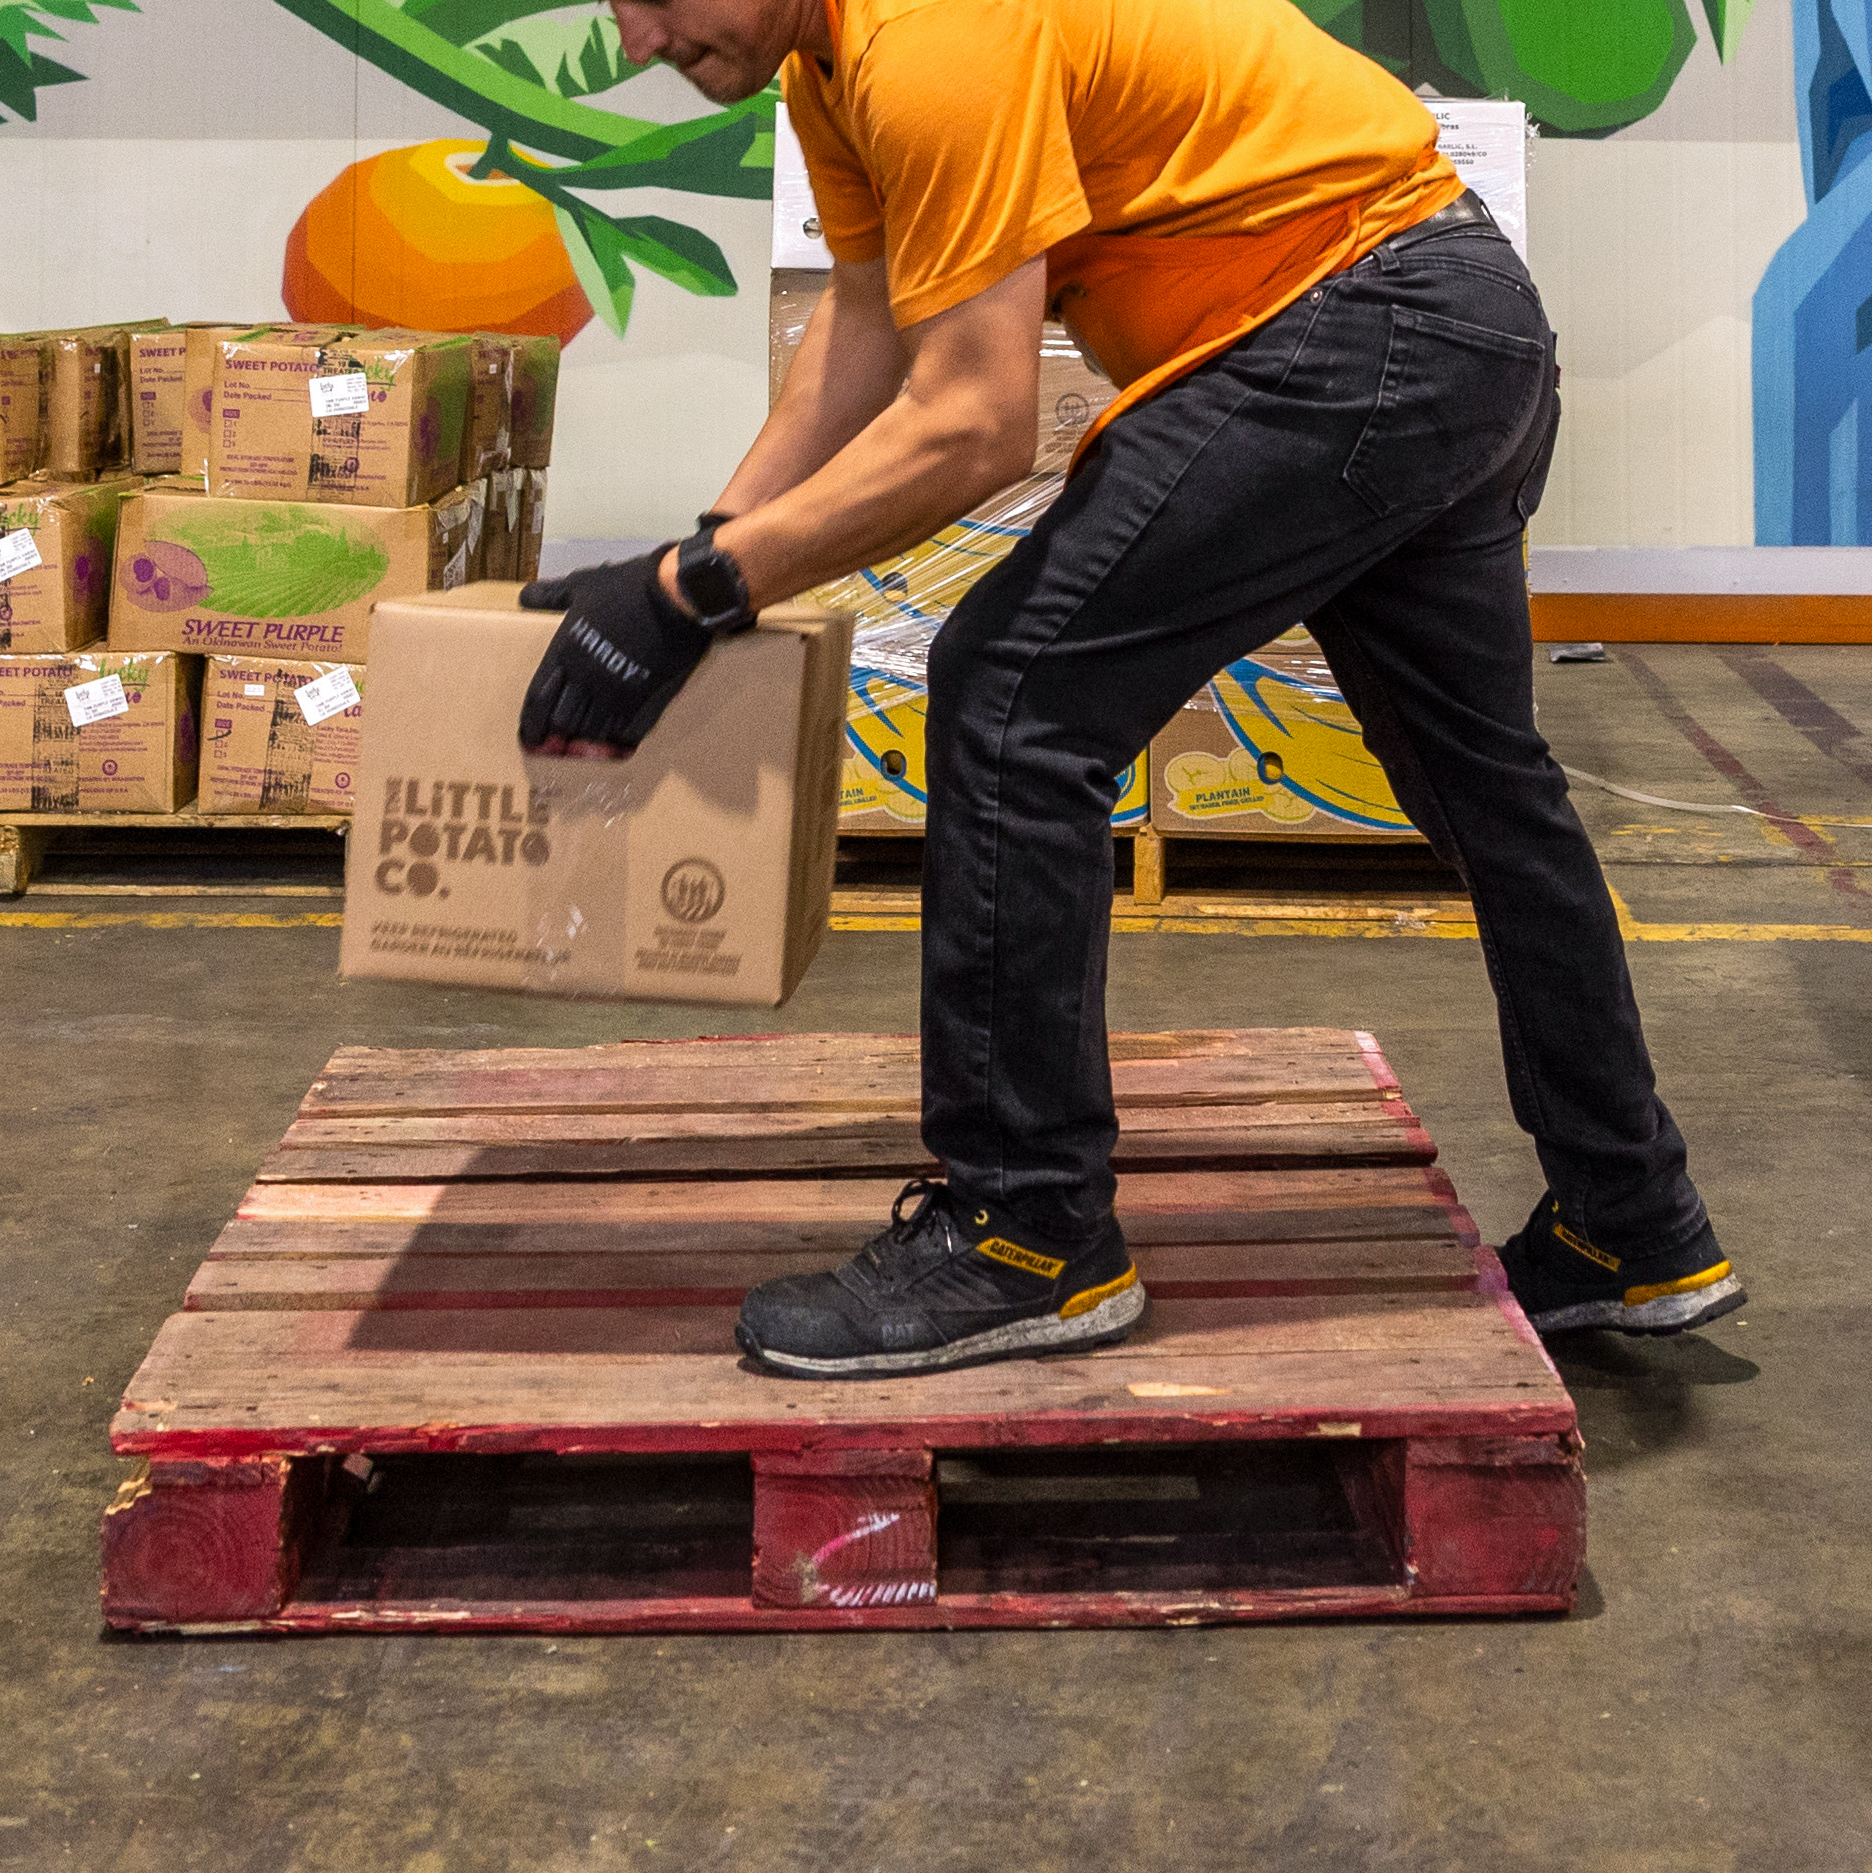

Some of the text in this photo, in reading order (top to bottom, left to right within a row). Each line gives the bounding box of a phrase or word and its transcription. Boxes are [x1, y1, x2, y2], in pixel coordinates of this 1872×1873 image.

[225, 360, 268, 372] SWEET
[182, 619, 345, 643] SWEET PURPLE
[182, 636, 198, 646] An
[265, 639, 297, 651] Sweet
[1195, 786, 1251, 802] PLANTAIN
[377, 818, 551, 868] POTATO
[374, 857, 451, 901] CO.
[989, 1241, 1056, 1272] CATERPILLAR
